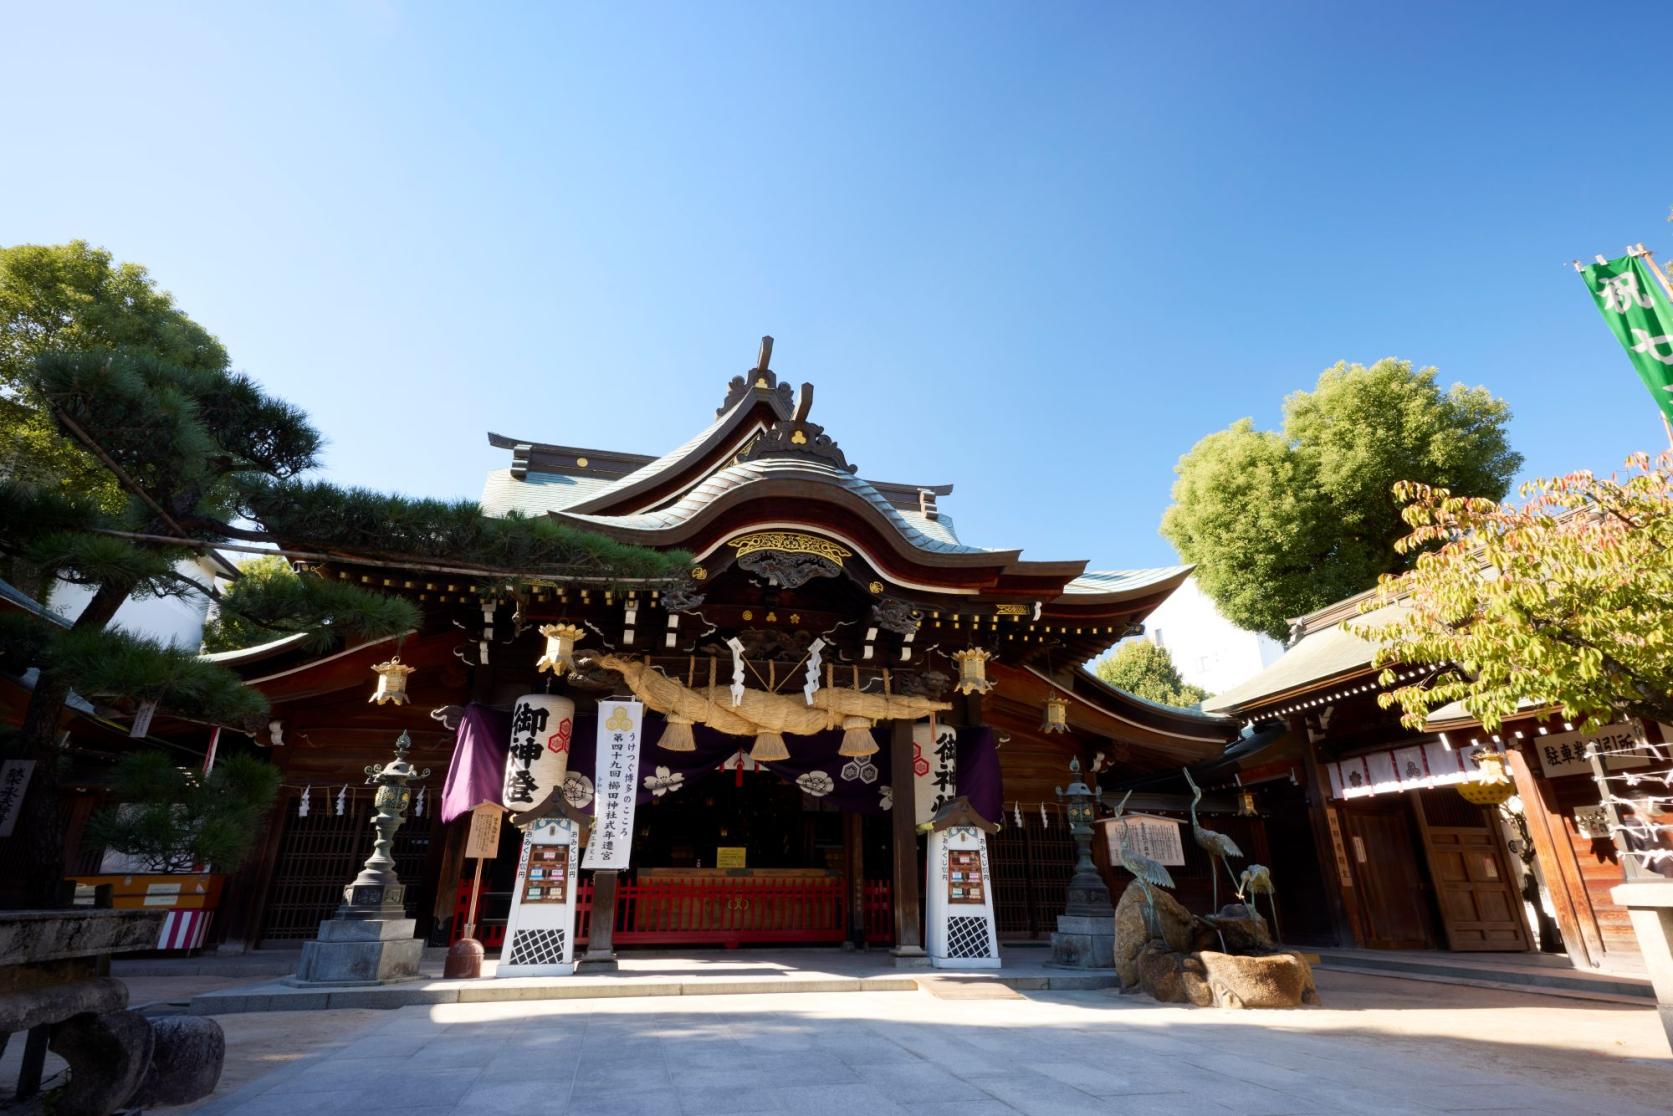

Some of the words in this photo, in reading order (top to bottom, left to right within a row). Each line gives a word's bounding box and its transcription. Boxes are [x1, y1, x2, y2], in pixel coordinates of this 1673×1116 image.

[619, 732, 637, 836] うけつぐ博多のこころ
